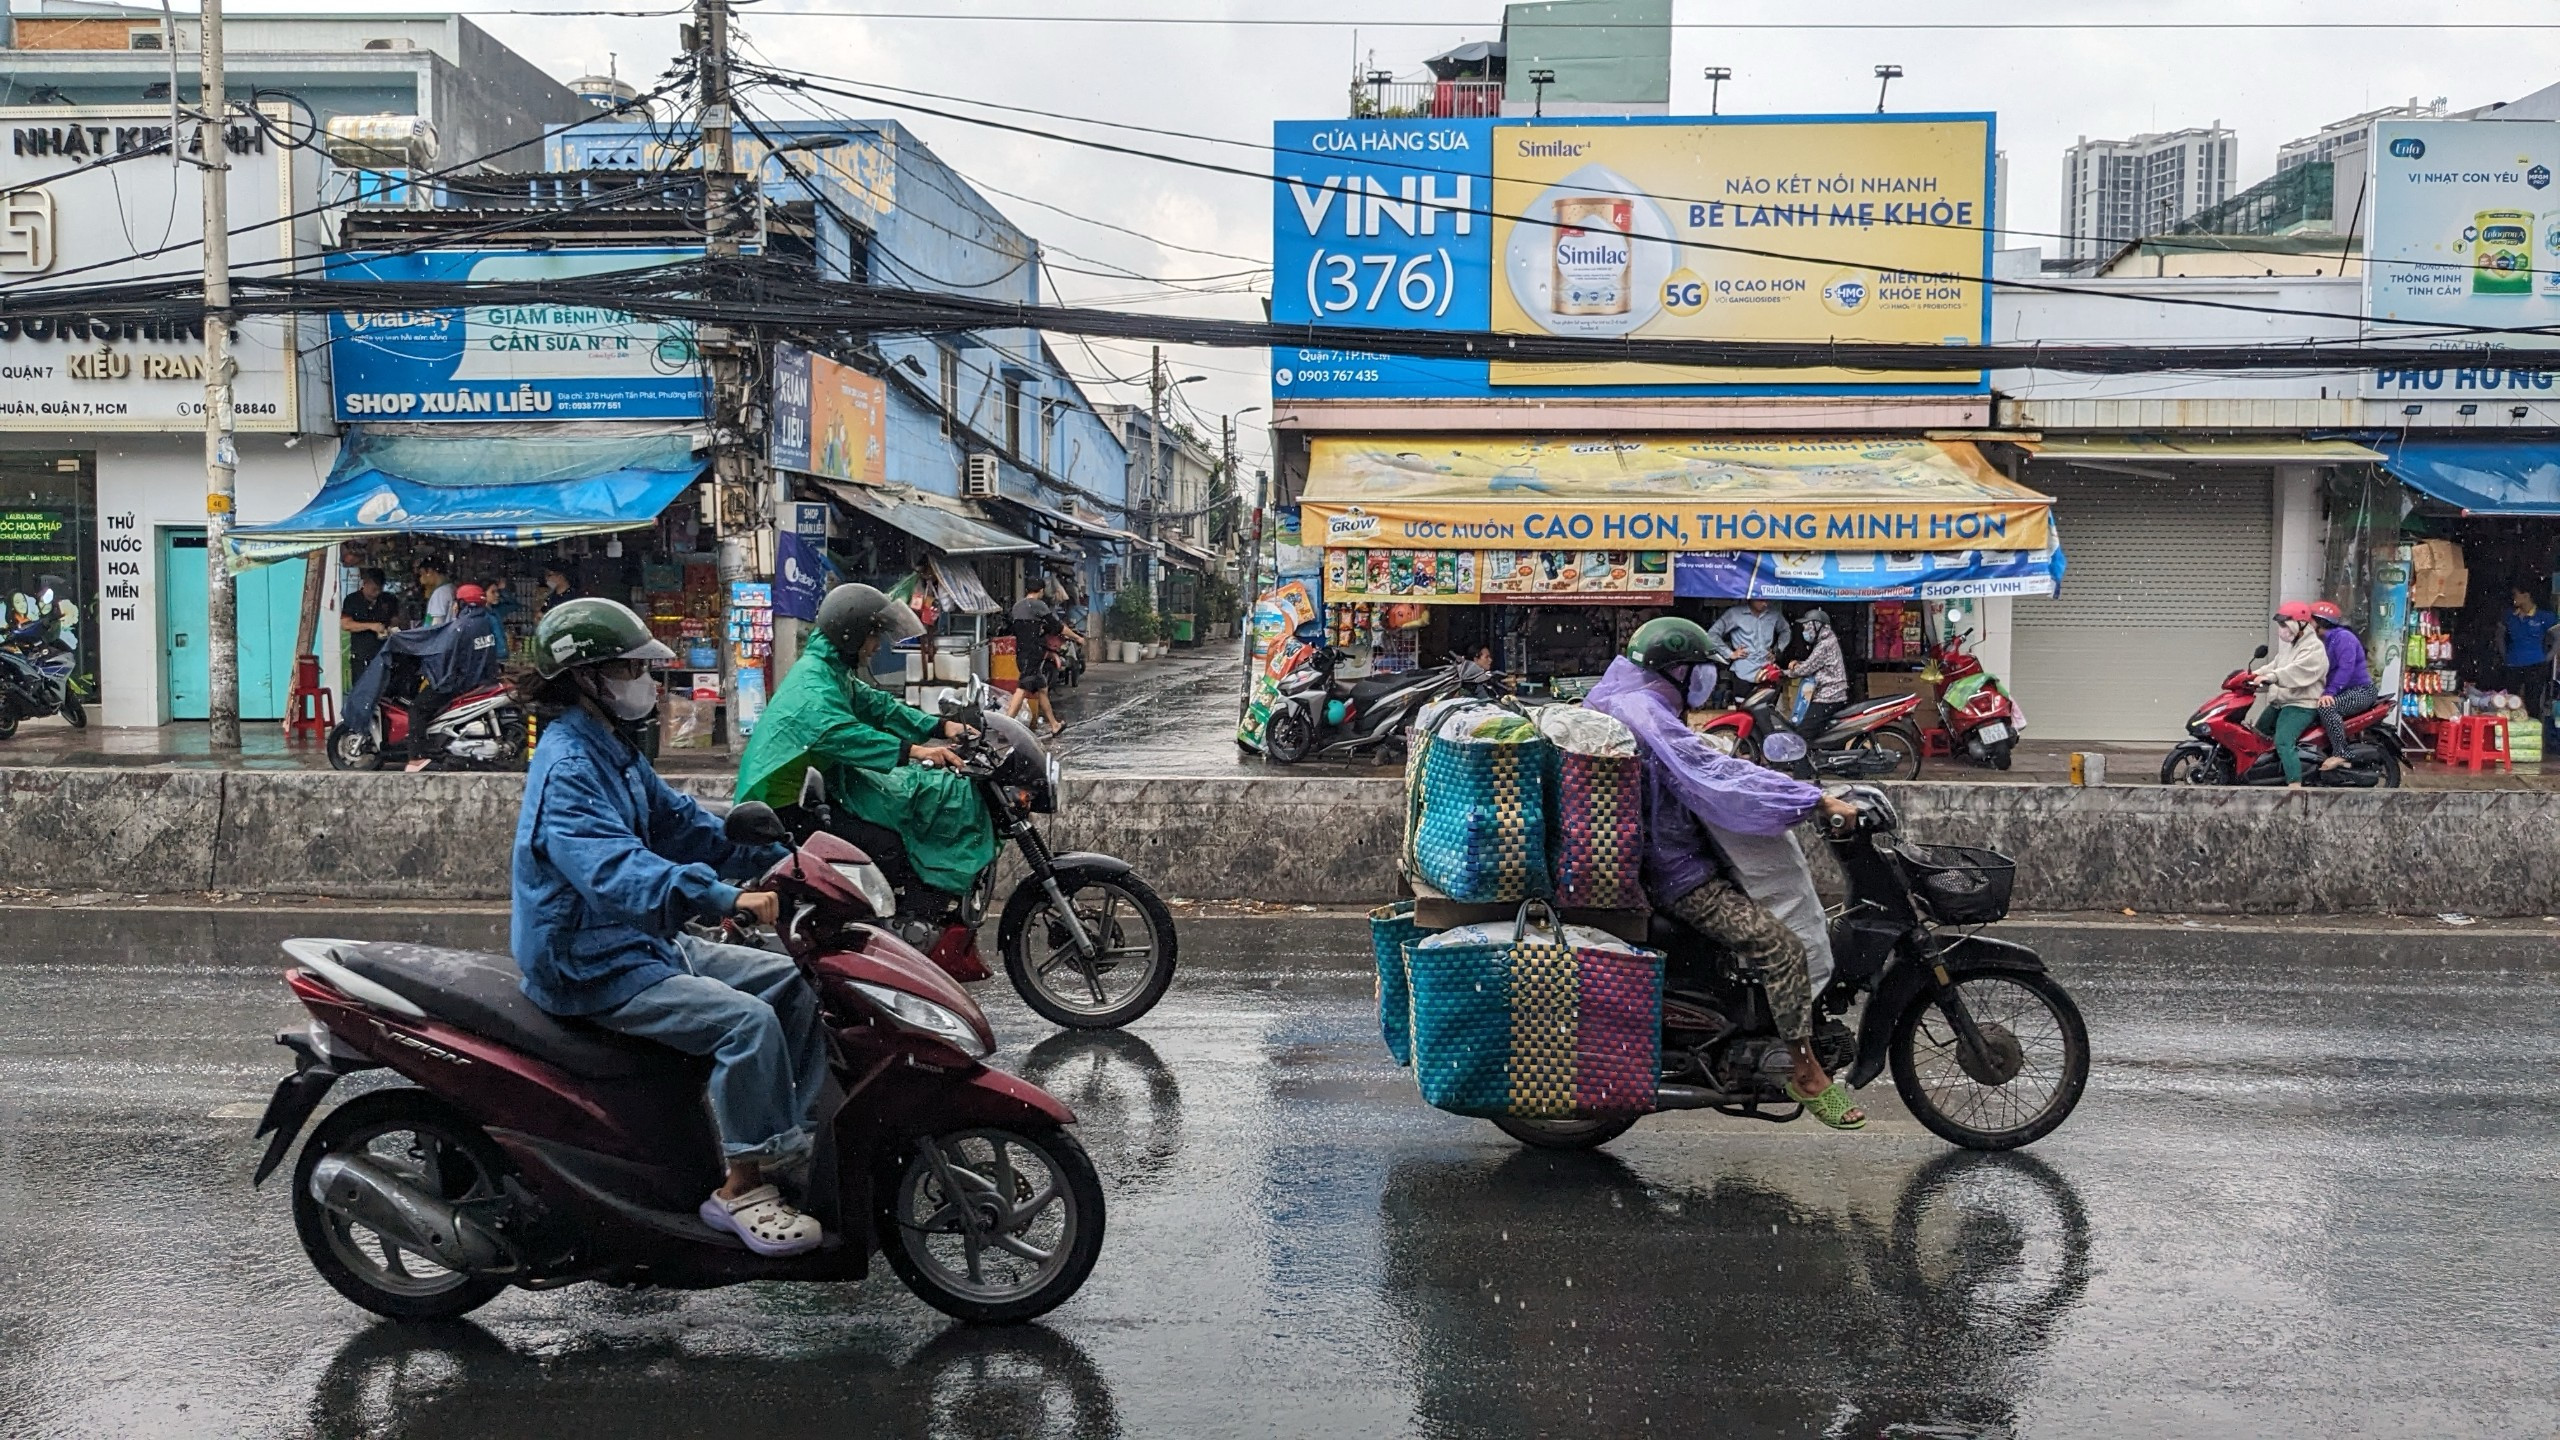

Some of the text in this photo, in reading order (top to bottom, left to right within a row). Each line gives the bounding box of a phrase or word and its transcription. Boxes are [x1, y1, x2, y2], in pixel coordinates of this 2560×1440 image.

[13, 123, 109, 163] NHẬT
[1313, 128, 1469, 151] CỬA HÀNG SỮA
[1726, 173, 1937, 194] NÃO KẾT NỐI NHANH
[2408, 173, 2420, 184] VỊ
[2462, 173, 2489, 183] CON
[2493, 171, 2518, 183] YÊU
[1286, 175, 1471, 237] VINH
[1689, 197, 1972, 231] BÉ LANH MẸ KHỎE
[1557, 244, 1627, 265] Similac
[1306, 248, 1454, 317] (376)
[1715, 279, 1805, 294] IQ CAO HƠN
[2390, 273, 2462, 283] THÔNG MINH
[1666, 284, 1702, 307] 5G
[1879, 286, 1961, 300] KHỎE HƠN
[2437, 285, 2461, 295] CẢM
[1299, 349, 1329, 363] Quận
[2, 365, 53, 380] QUẬN 7
[1299, 370, 1379, 382] 0903 767 435
[346, 383, 551, 413] SHOP XUÂN LIỄU
[41, 400, 80, 416] QUẬN
[83, 403, 93, 416] 7,
[96, 403, 127, 414] HCM
[16, 522, 36, 531] HOA
[38, 520, 62, 531] PHÁP
[107, 511, 135, 529] THỬ
[1332, 518, 1376, 532] GROW
[1405, 509, 2006, 546] ƯỚC MUỐN CAO HƠN, THÔNG MINH HƠN
[100, 534, 142, 552] NƯỚC
[108, 562, 140, 575] HOA
[106, 580, 139, 598] MIỄN
[1926, 585, 1960, 596] SHOP
[1964, 584, 1986, 596] CHỊ
[1989, 582, 2021, 594] VINH
[111, 603, 135, 621] PHÍ
